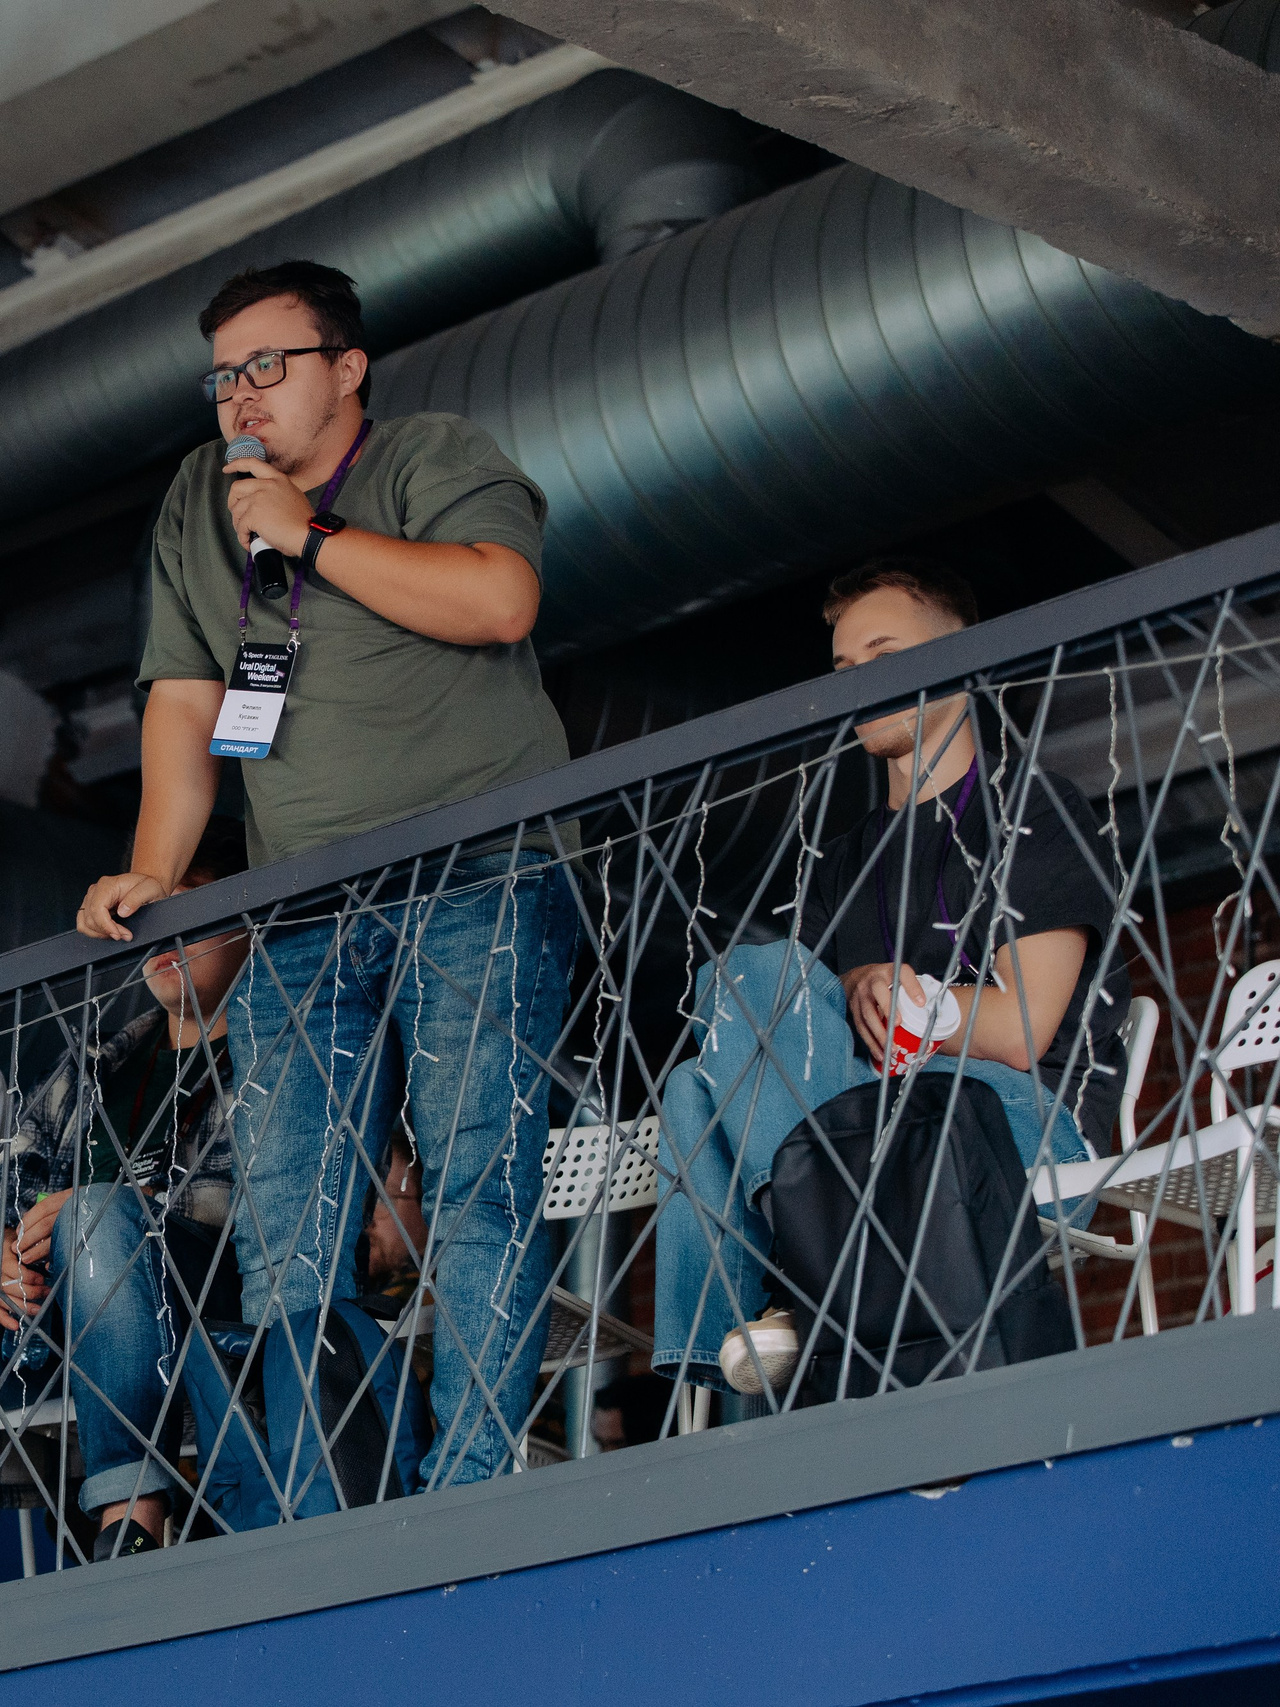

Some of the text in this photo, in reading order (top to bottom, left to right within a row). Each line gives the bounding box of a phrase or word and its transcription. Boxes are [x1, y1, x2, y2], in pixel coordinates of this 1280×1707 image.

[239, 661, 276, 673] Ural Digital
[247, 672, 278, 682] Weekend
[241, 703, 262, 711] Филипп
[220, 744, 259, 753] СТАНДАРТ
[132, 1157, 153, 1168] Digital
